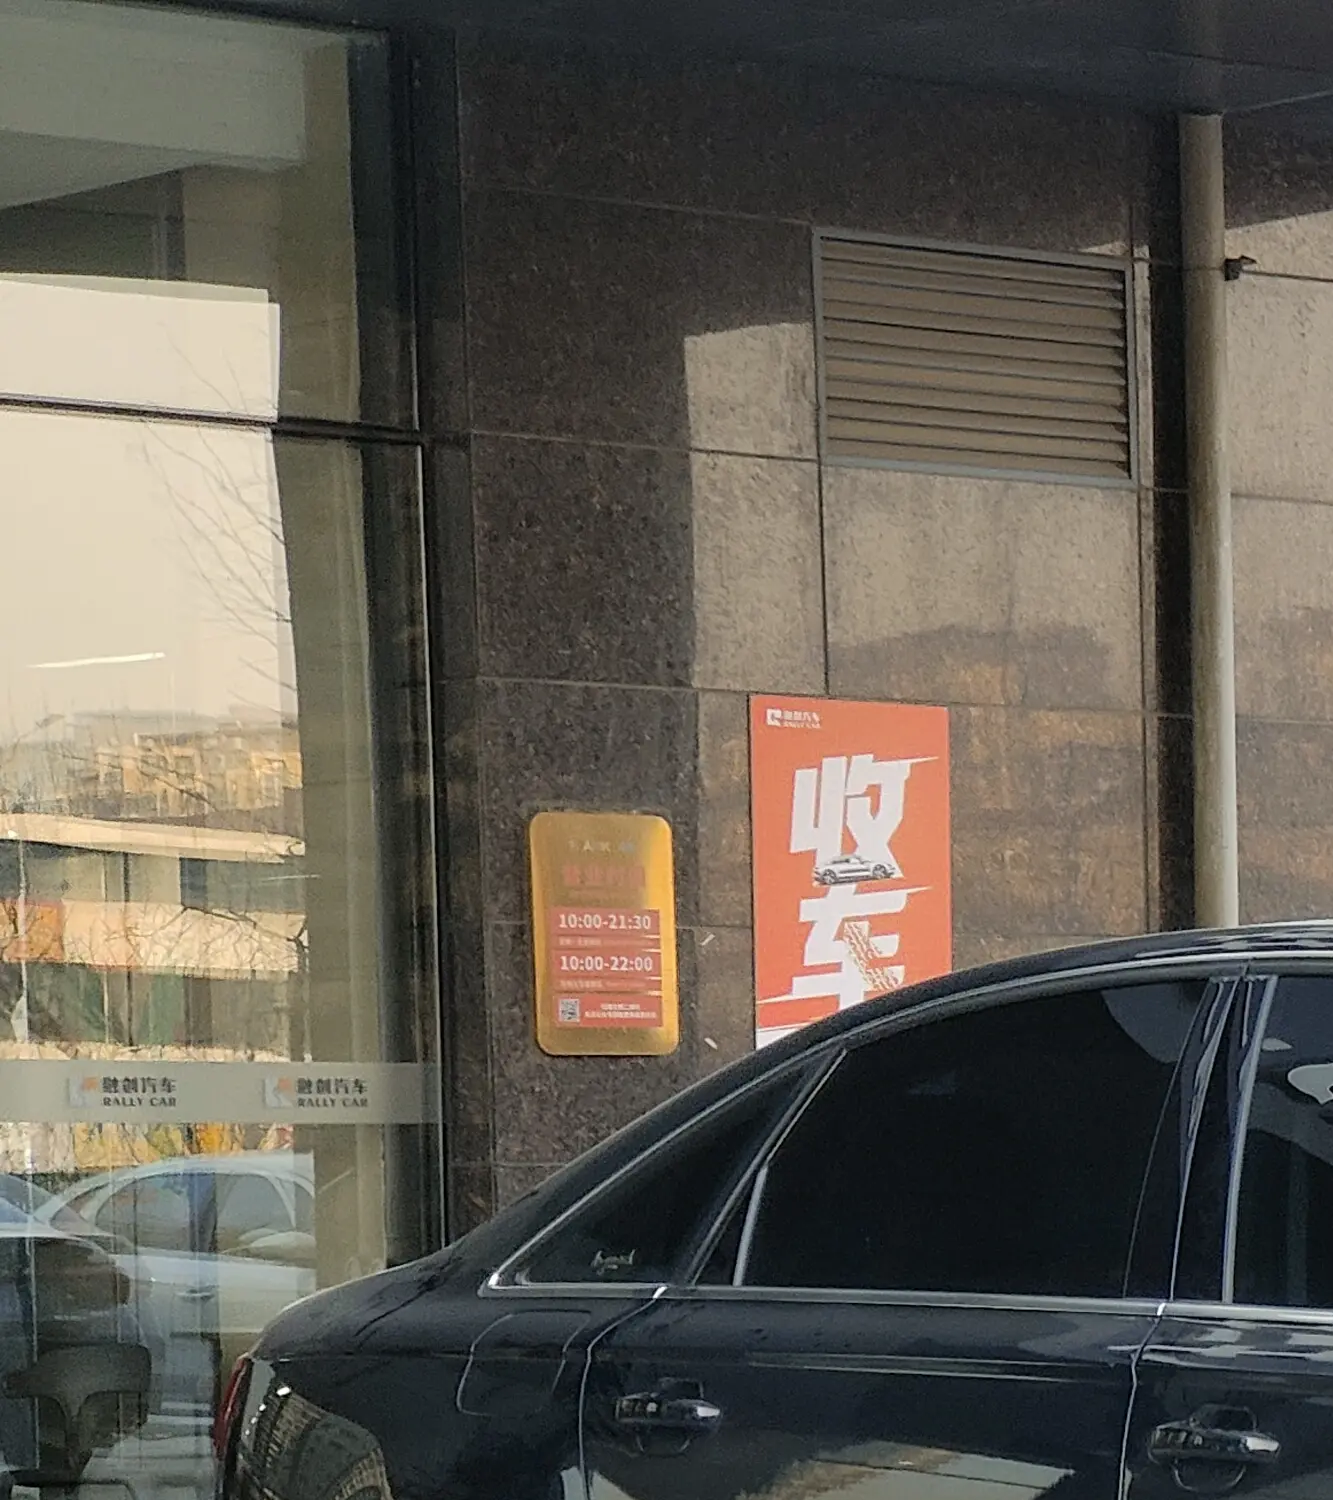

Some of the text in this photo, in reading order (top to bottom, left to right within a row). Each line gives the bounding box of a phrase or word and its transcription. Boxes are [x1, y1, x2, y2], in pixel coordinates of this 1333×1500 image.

[780, 752, 938, 1012] 收车
[558, 913, 652, 930] 10:00-21:30
[559, 955, 654, 972] 10:00-22:00
[102, 1076, 177, 1094] 融创汽车
[102, 1096, 177, 1107] RALLY CAR
[298, 1097, 368, 1108] RALLY CAR
